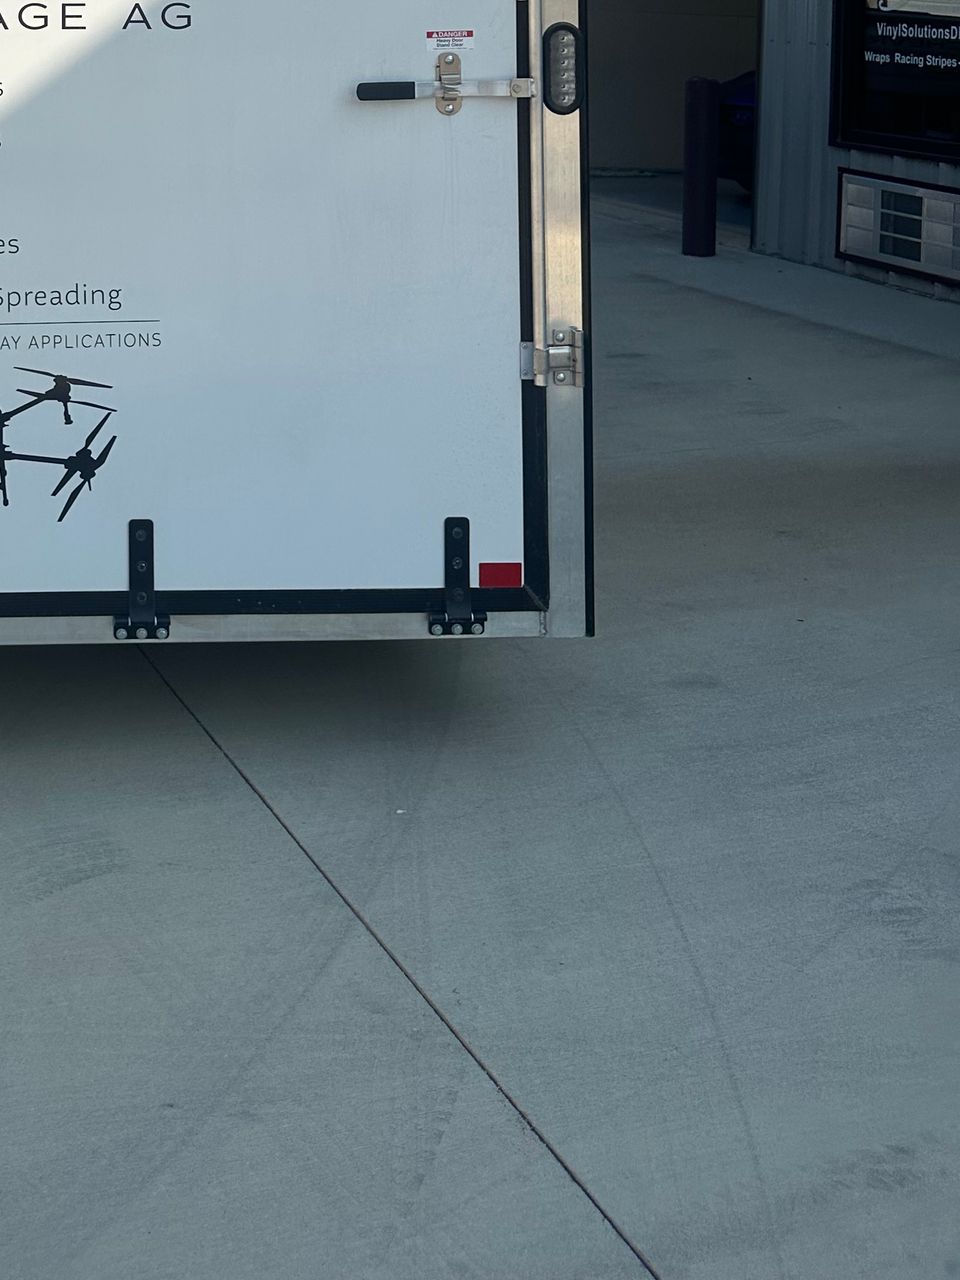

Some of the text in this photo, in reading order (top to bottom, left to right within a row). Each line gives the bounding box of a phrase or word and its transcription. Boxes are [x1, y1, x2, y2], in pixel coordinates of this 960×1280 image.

[121, 1, 194, 31] AG
[864, 51, 957, 69] Wraps Racing Stripes
[28, 332, 163, 350] APPLICATIONS
